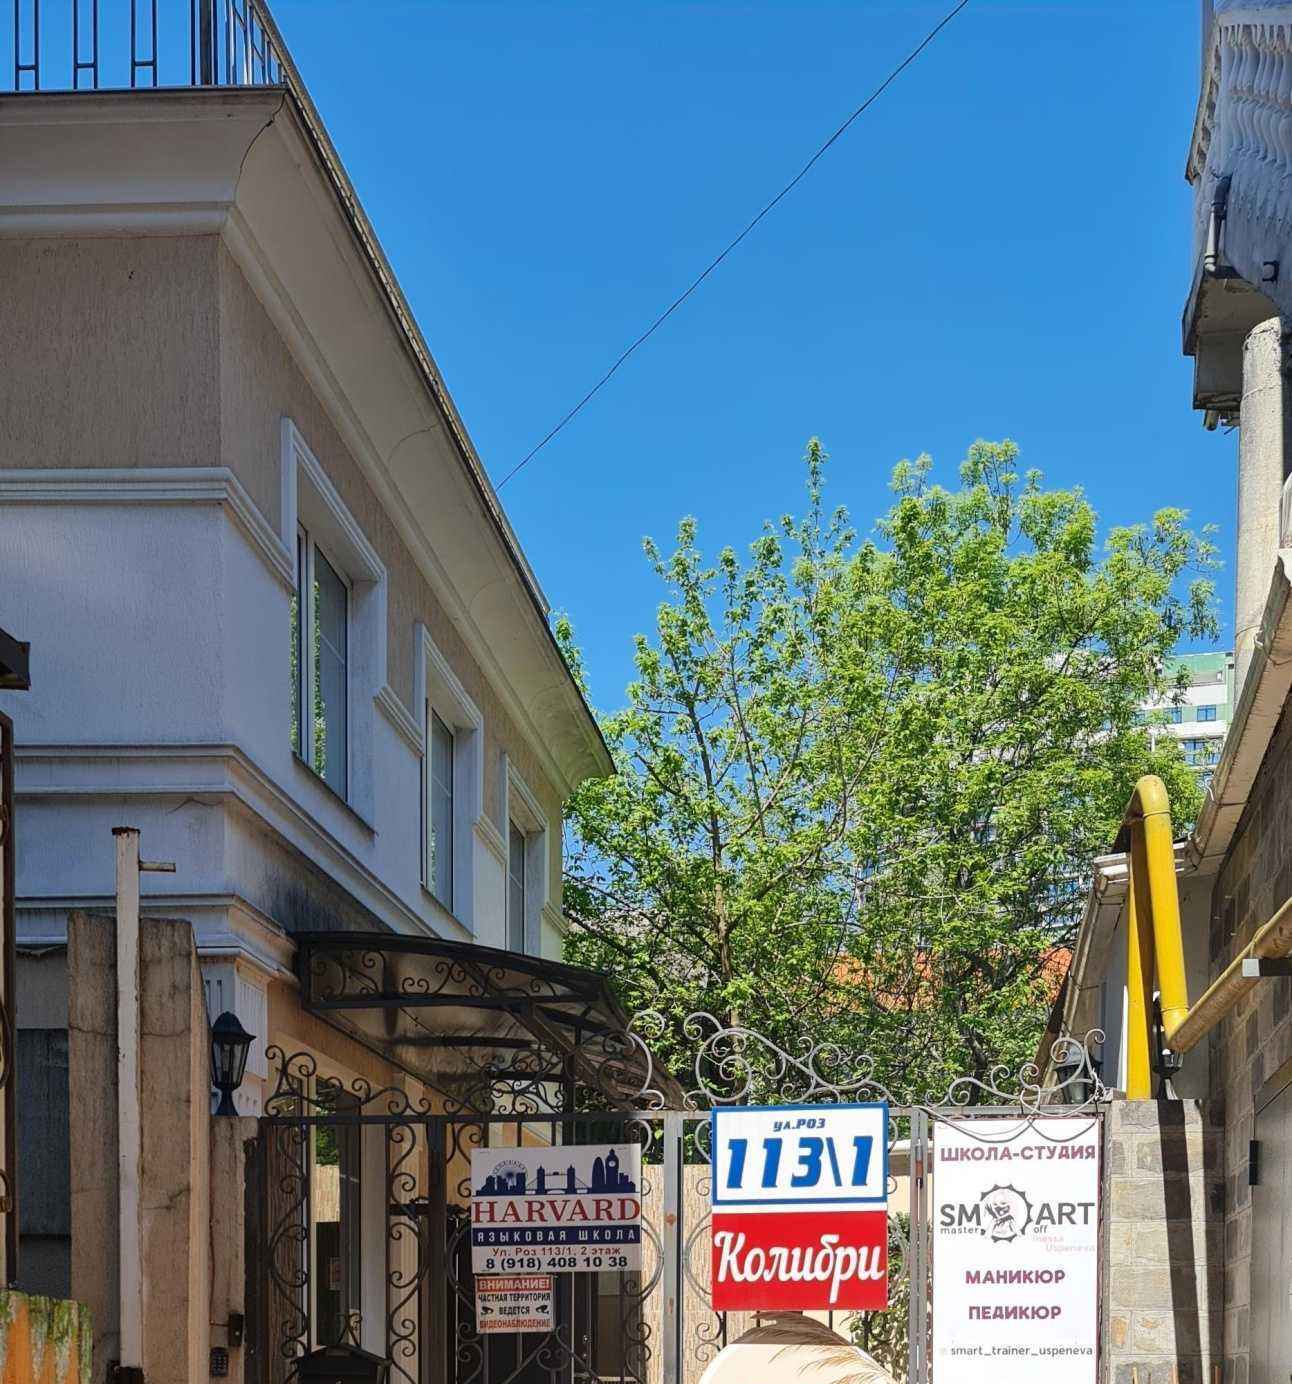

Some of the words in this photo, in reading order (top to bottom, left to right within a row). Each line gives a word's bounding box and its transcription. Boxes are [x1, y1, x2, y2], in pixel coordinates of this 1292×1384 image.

[940, 1145, 1096, 1162] ШКОЛА-СТУДИЯ
[726, 1135, 874, 1189] 113\1
[472, 1199, 641, 1223] HARVARD
[478, 1229, 566, 1243] ЯЗЫКОВАЯ
[578, 1228, 635, 1242] ШКОЛА
[492, 1247, 511, 1257] Ул.
[515, 1247, 537, 1256] Роз
[581, 1246, 587, 1255] 2
[591, 1247, 621, 1255] этаж
[486, 1258, 495, 1269] 8
[501, 1258, 541, 1270] (918)
[547, 1257, 577, 1268] 408
[583, 1257, 602, 1267] 10
[608, 1256, 628, 1267] 38
[714, 1230, 885, 1304] Колибри
[965, 1270, 1065, 1284] МАНИКЮР
[480, 1279, 550, 1290] ВНИМАНИЕ!
[479, 1293, 508, 1302] ЧАСТНАЯ
[509, 1292, 550, 1302] ТЕРРИТОРИЯ
[968, 1306, 1062, 1320] ПЕДИКЮР
[951, 1346, 1093, 1358] smart_trainer_uspeneva
